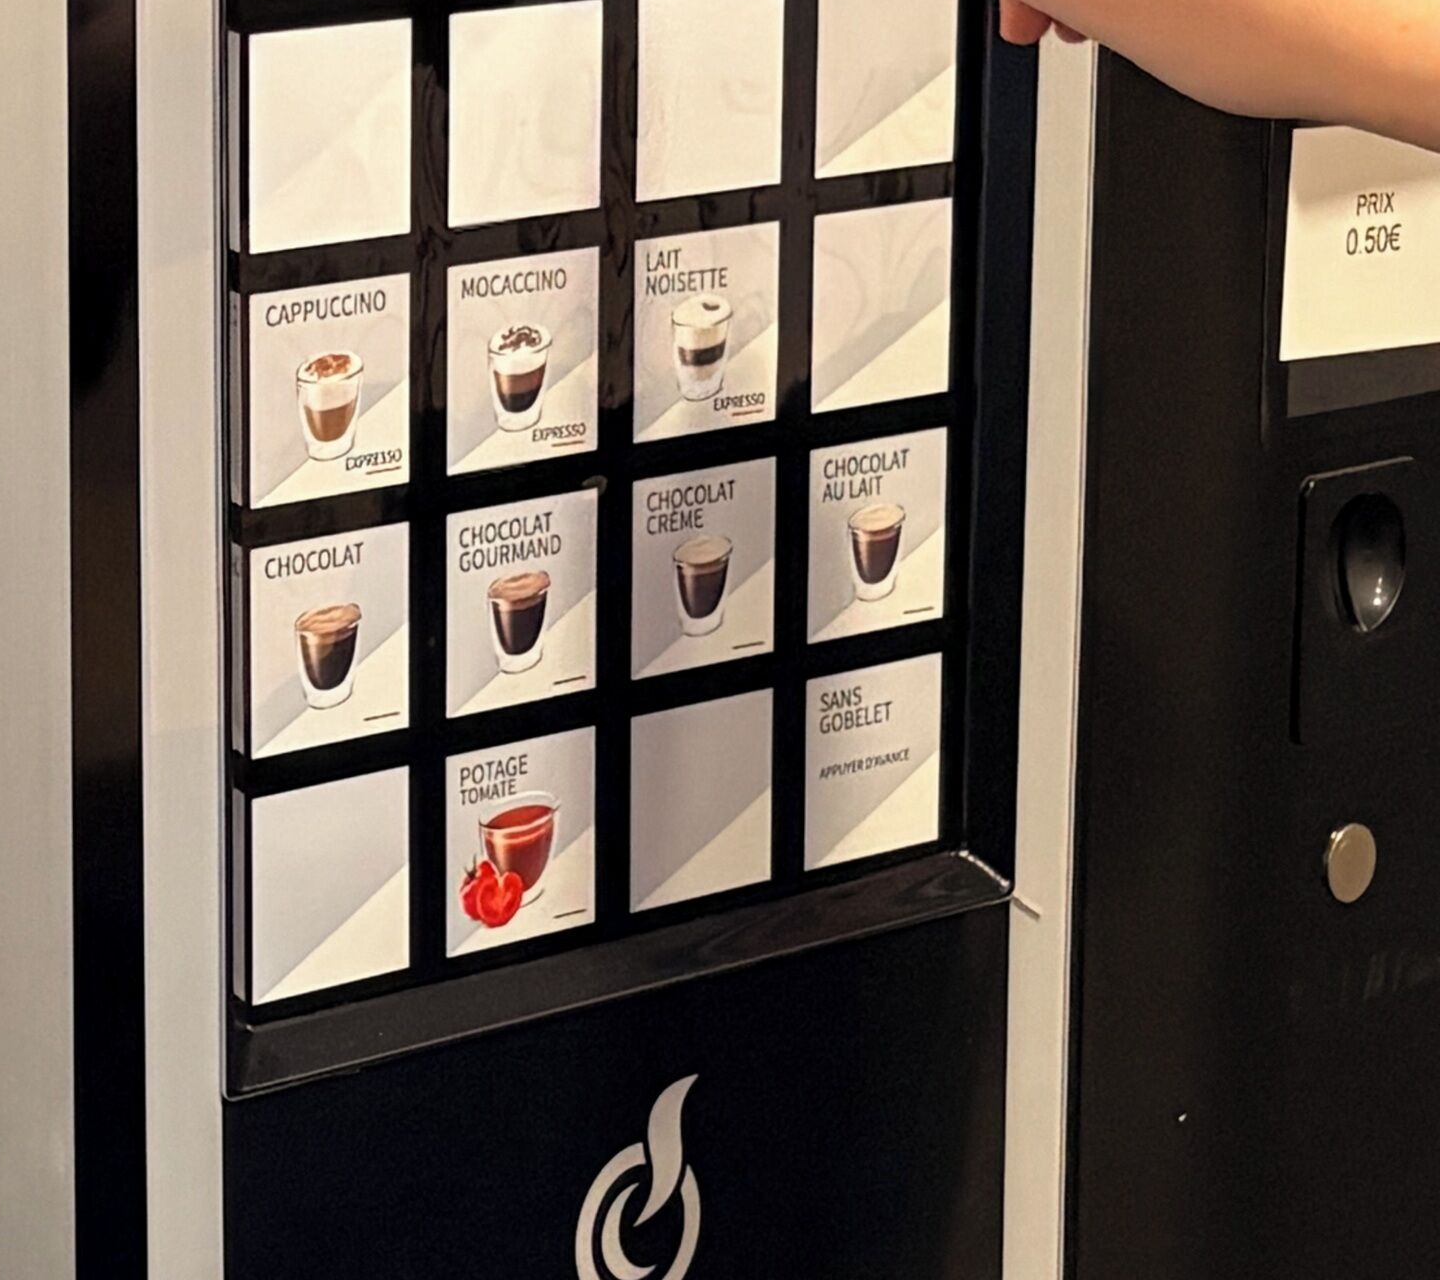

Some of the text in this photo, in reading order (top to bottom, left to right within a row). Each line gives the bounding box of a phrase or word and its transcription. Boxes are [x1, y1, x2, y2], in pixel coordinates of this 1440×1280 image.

[1356, 192, 1394, 216] PRIX
[1346, 223, 1402, 256] 0.50€
[645, 248, 682, 273] LAIT
[461, 267, 567, 300] MOCACCINO
[645, 267, 728, 296] NOISETTE
[265, 289, 387, 328] CAPPUCCINO
[713, 392, 766, 412] EXPRESSO
[531, 422, 587, 443] EXPRESSO
[345, 448, 403, 472] EXPRESSO
[823, 448, 910, 481] CHOCOLAT
[646, 479, 736, 513] CHOCOLAT
[822, 475, 884, 503] AU LAIT
[459, 512, 554, 550] CHOCOLAT
[264, 541, 365, 580] CHOCOLAT
[459, 534, 562, 573] GOURMAND
[819, 685, 863, 713] SANS
[819, 700, 893, 734] GOBELET
[459, 753, 529, 788] POTAGE
[819, 748, 910, 780] APPUYER D'AVANCE
[459, 778, 517, 807] TOMATE
